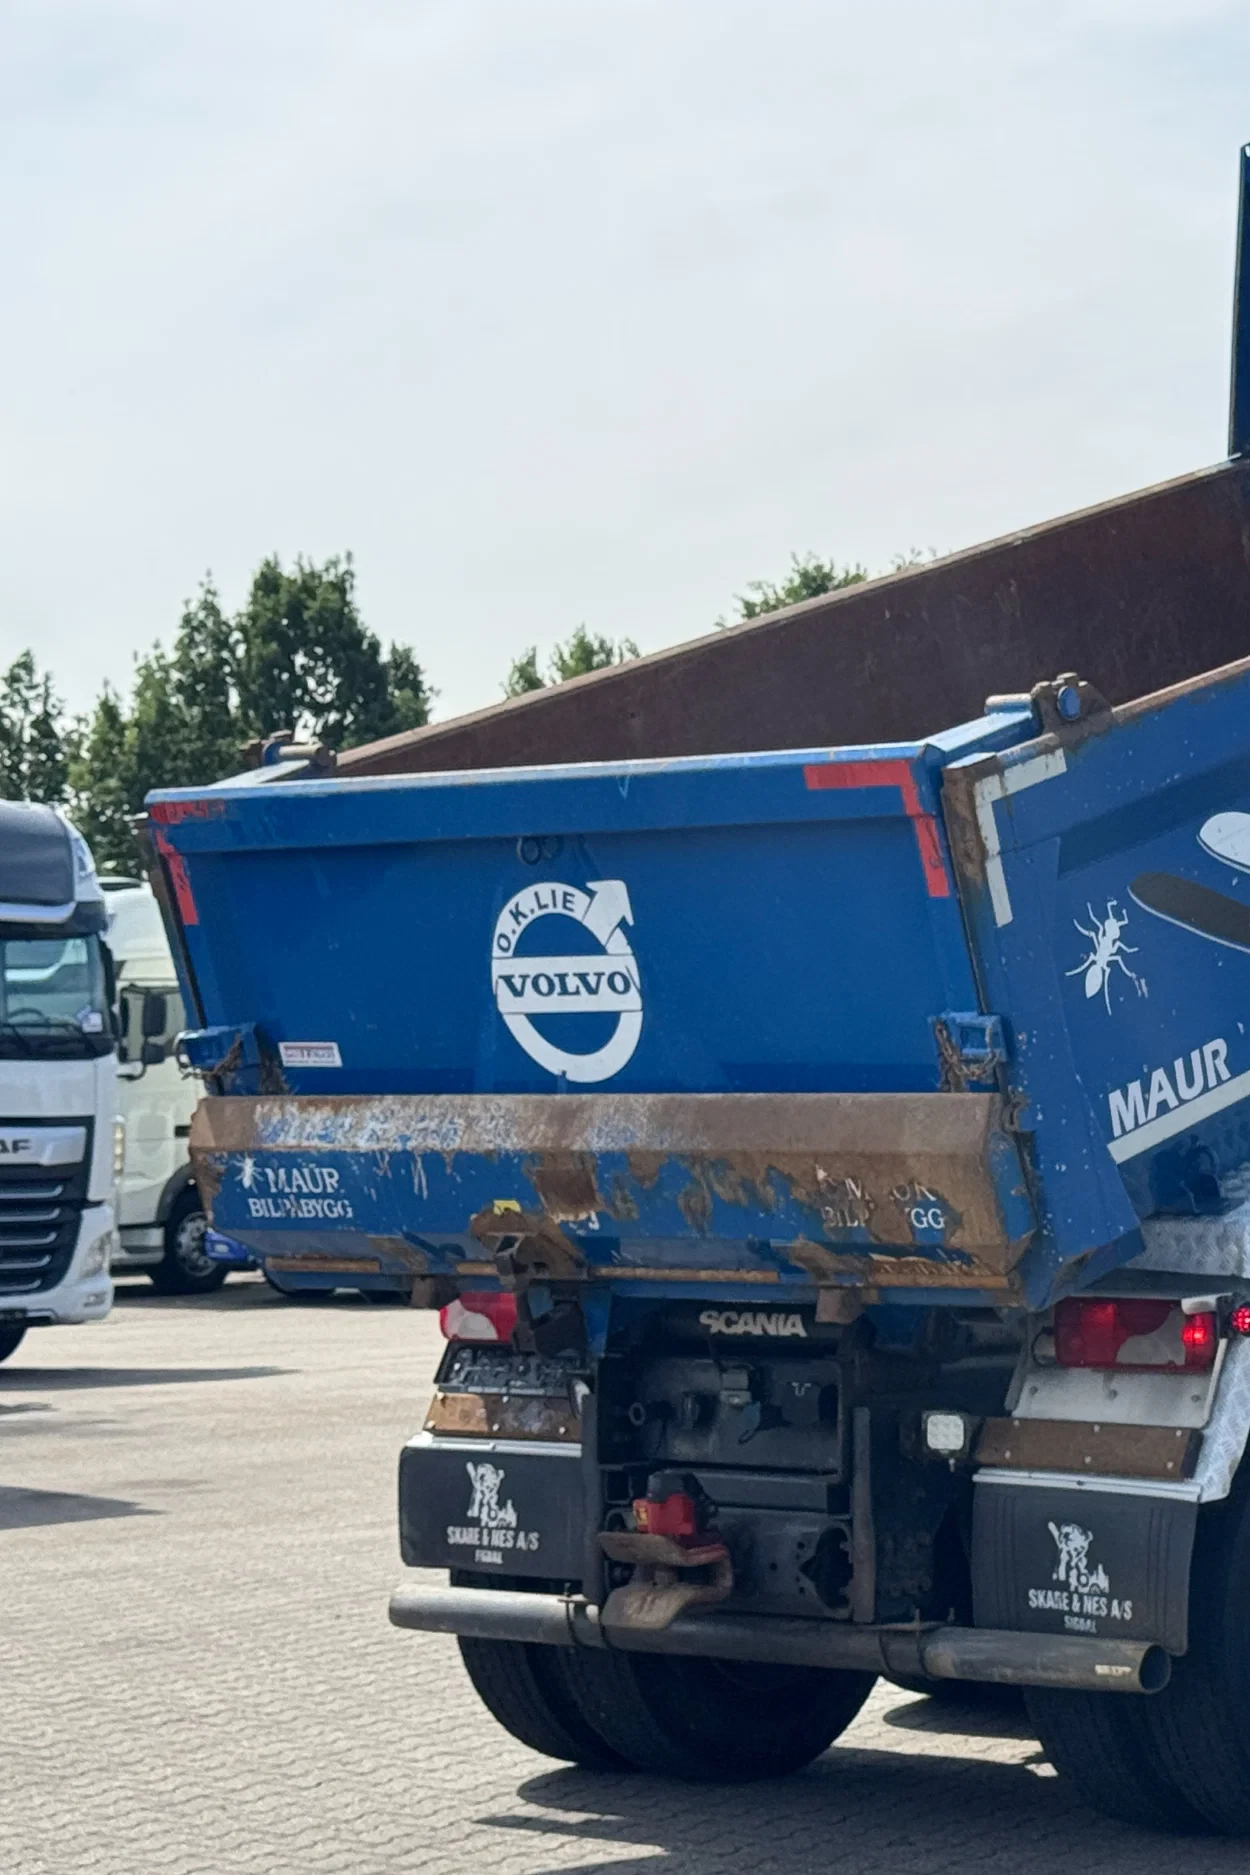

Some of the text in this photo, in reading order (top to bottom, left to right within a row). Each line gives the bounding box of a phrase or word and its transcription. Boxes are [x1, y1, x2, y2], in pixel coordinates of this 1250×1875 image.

[496, 889, 577, 953] O.K.LIE
[498, 971, 631, 998] VOLVO
[1108, 1038, 1232, 1138] MAUR
[699, 1309, 808, 1337] SCANIA
[1071, 1592, 1081, 1613] &
[1083, 1595, 1108, 1617] NES
[1110, 1598, 1133, 1620] A/S
